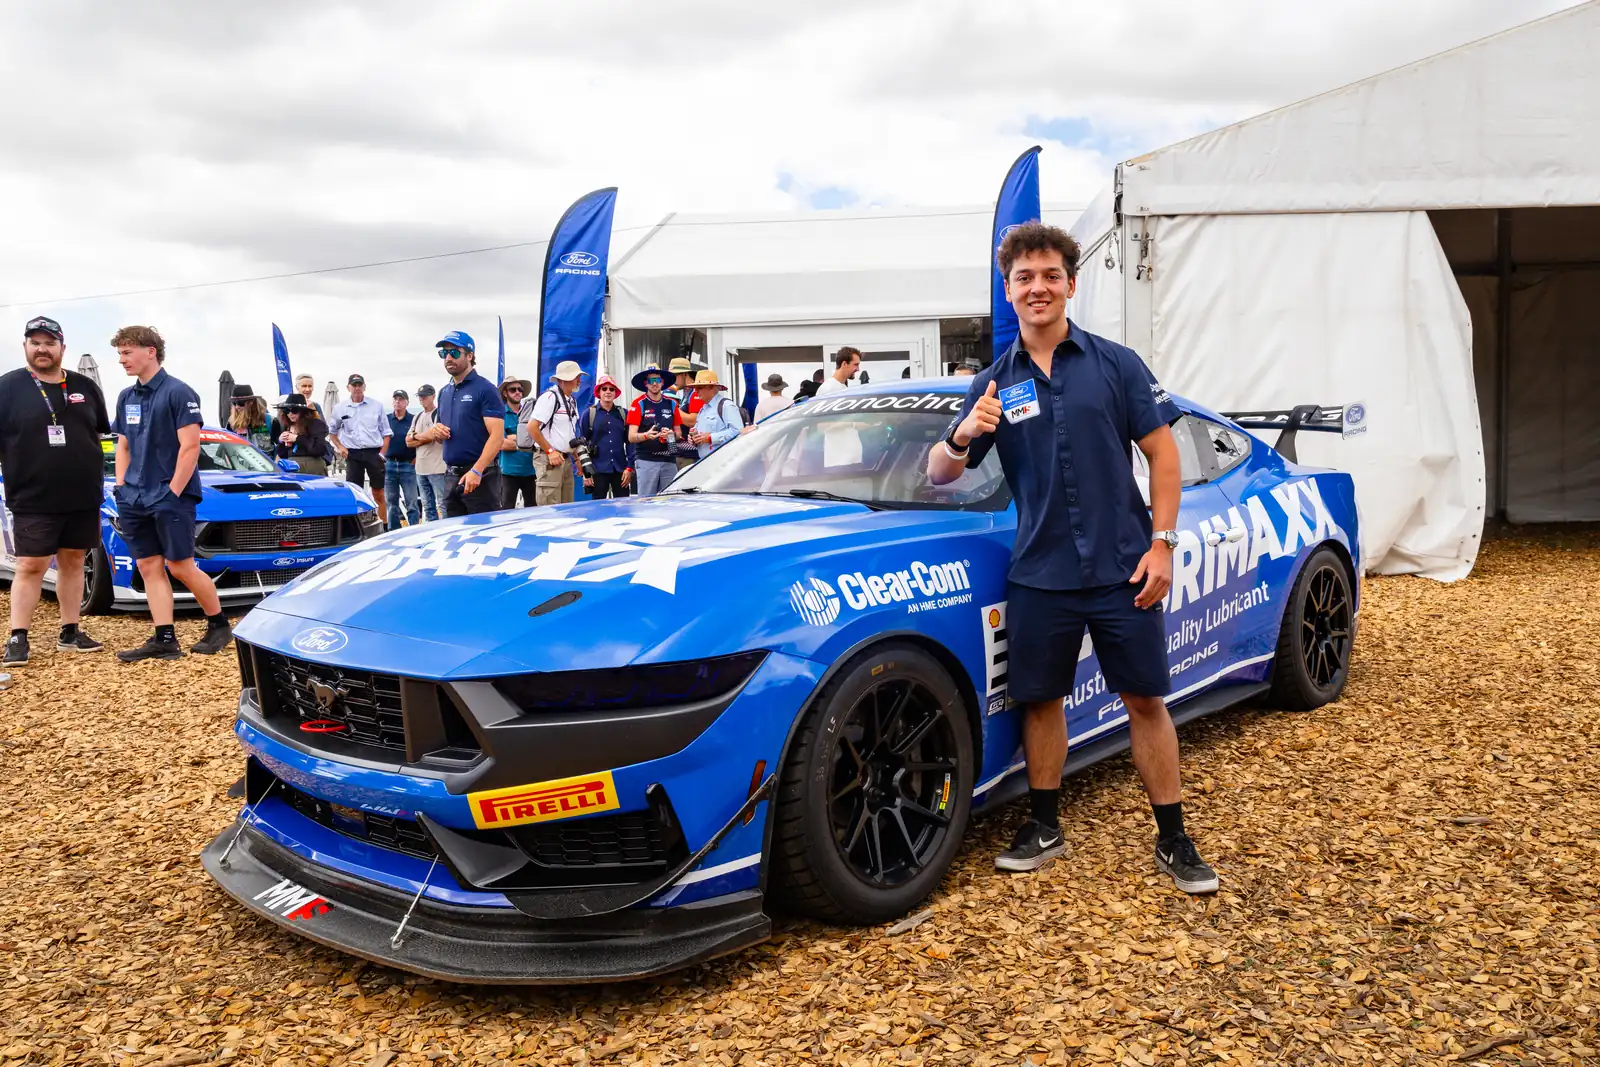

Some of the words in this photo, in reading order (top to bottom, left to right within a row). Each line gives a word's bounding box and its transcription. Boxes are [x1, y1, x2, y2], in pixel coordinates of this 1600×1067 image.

[566, 253, 592, 265] Ford
[555, 268, 601, 276] RACING
[803, 392, 965, 415] Monochro
[200, 432, 232, 440] raft
[1161, 476, 1338, 614] RIMAXX
[907, 602, 920, 614] AN
[919, 599, 938, 612] HME
[937, 593, 973, 609] COMPANY
[298, 629, 338, 651] Ford
[1063, 670, 1106, 710] Austr
[1166, 617, 1204, 654] uality
[1205, 580, 1270, 632] Lubricant
[1098, 697, 1124, 721] FO
[1169, 641, 1219, 678] ACING
[478, 780, 606, 823] PIRELLI
